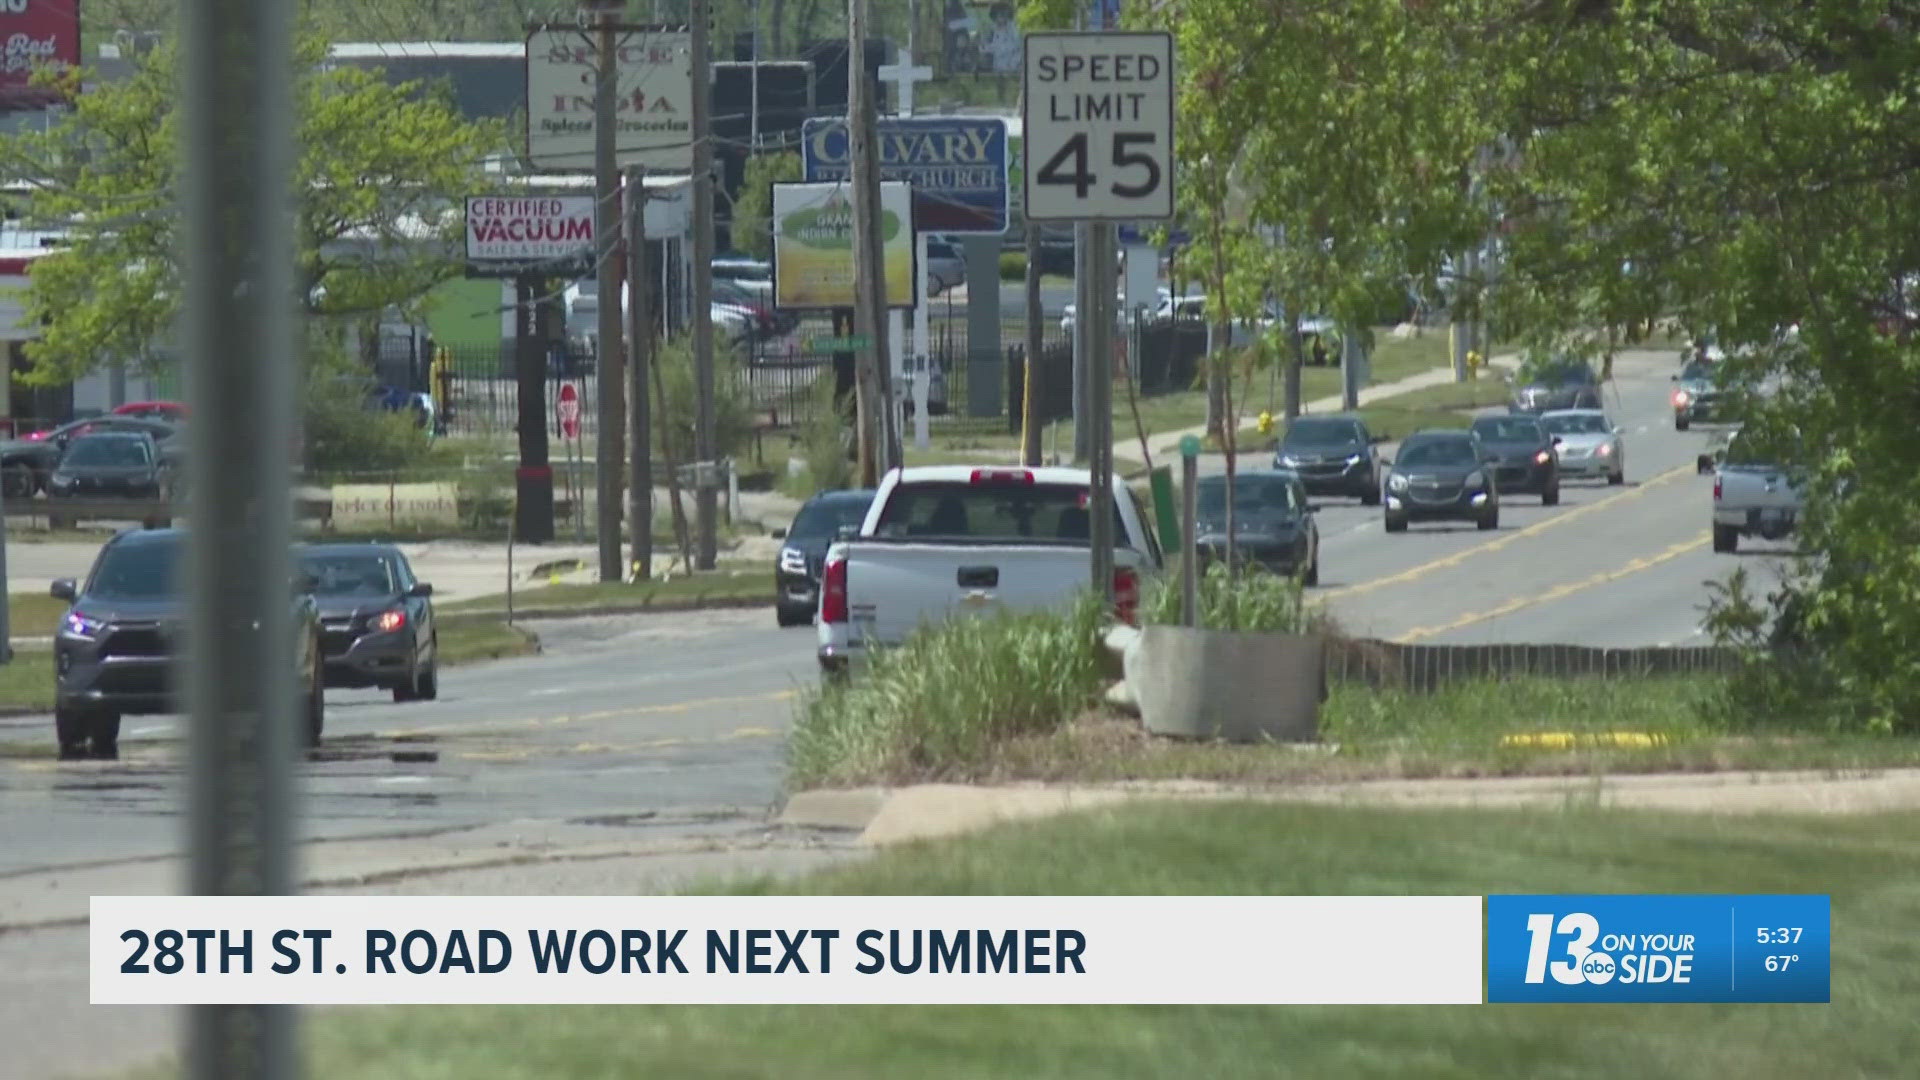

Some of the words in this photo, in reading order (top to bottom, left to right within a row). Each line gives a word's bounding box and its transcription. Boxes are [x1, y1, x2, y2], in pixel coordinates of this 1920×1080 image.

[548, 47, 673, 64] SPCE
[1038, 55, 1160, 82] SPEED
[1050, 93, 1146, 122] LIMIT
[812, 124, 996, 164] CLVARY
[1036, 132, 1161, 199] 45
[471, 199, 563, 216] CERTIFIED
[470, 217, 592, 243] VACUUM
